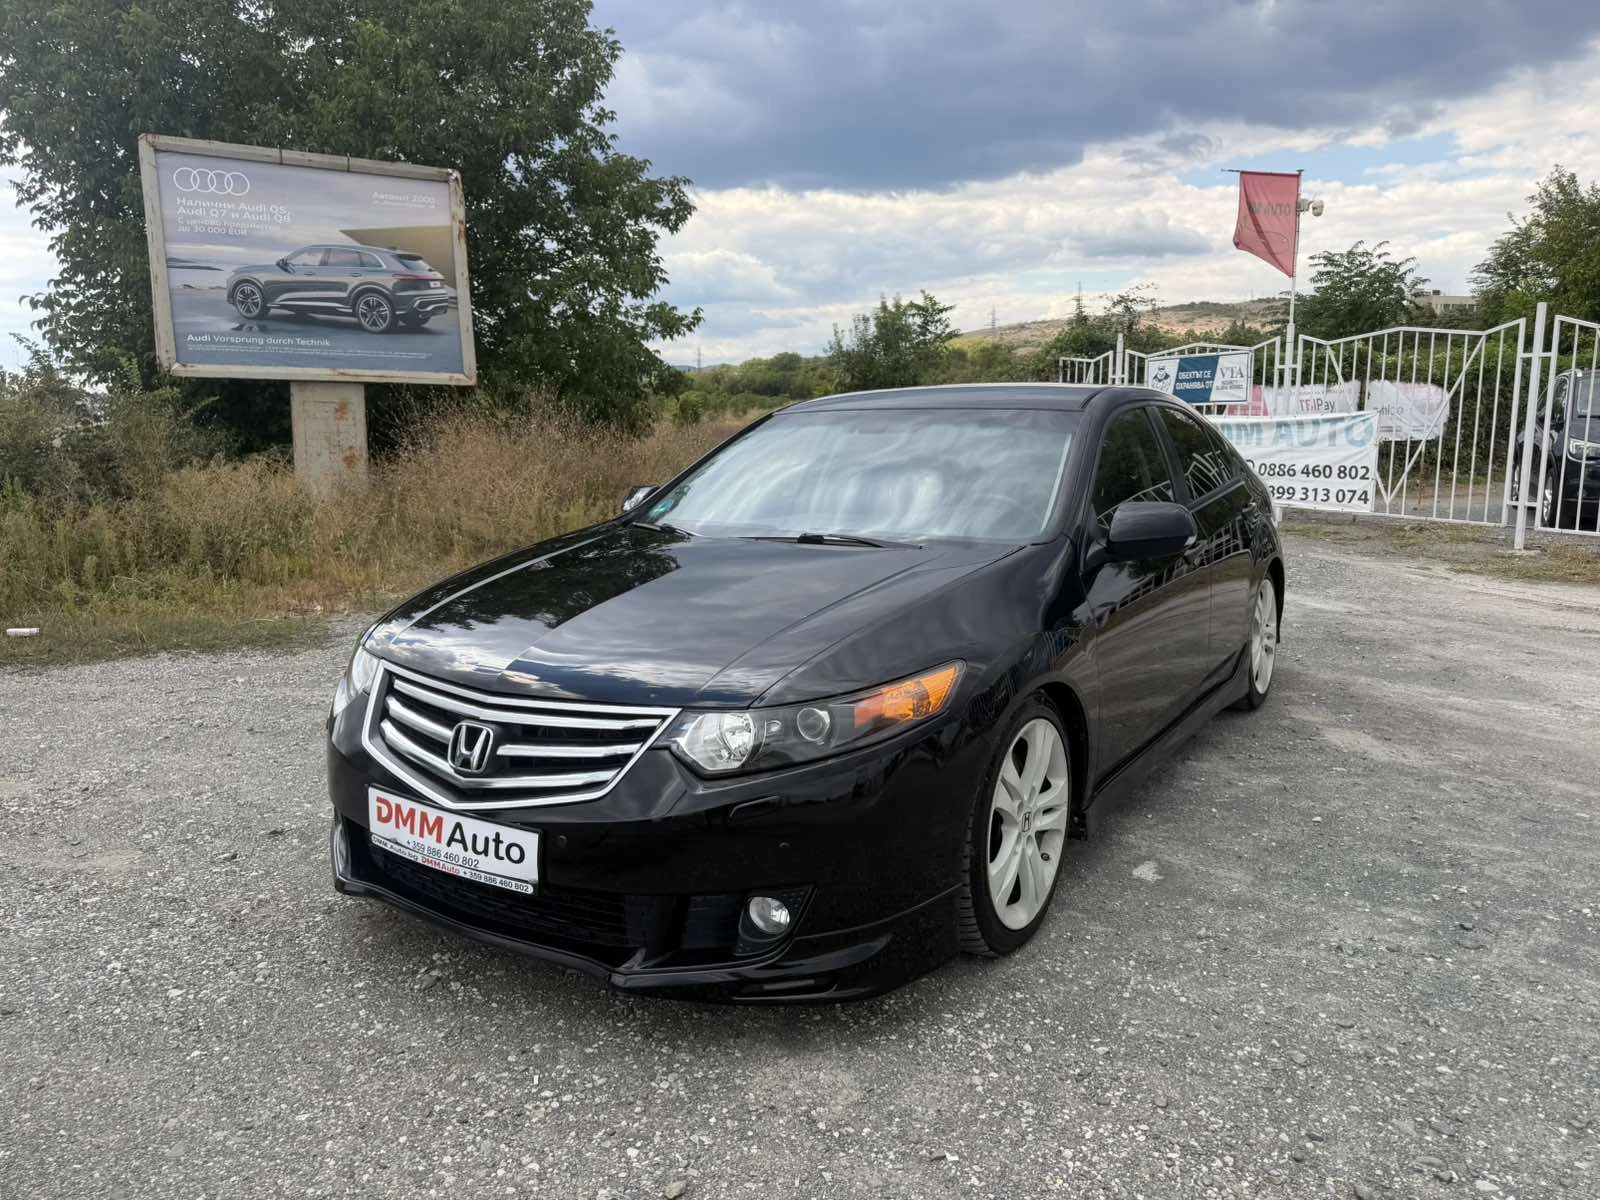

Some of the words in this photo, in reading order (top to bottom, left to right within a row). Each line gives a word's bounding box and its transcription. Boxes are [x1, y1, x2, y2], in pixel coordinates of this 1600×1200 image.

[176, 206, 207, 217] Audi
[209, 208, 226, 219] Q7
[242, 211, 271, 222] Audi
[239, 202, 266, 212] Audi
[187, 333, 211, 342] Audi
[213, 335, 264, 346] Vorsprung
[266, 336, 295, 346] durch
[296, 337, 331, 347] Technik
[1219, 367, 1245, 379] VTA
[1271, 415, 1375, 449] AUTO
[1257, 462, 1297, 477] 0886
[1300, 464, 1333, 479] 460
[1336, 465, 1370, 481] 802
[1300, 487, 1330, 502] 313
[1335, 488, 1370, 505] 074
[426, 845, 443, 859] 886
[443, 851, 460, 864] 460
[461, 855, 480, 869] 802
[498, 879, 513, 890] 460
[514, 883, 530, 894] 802
